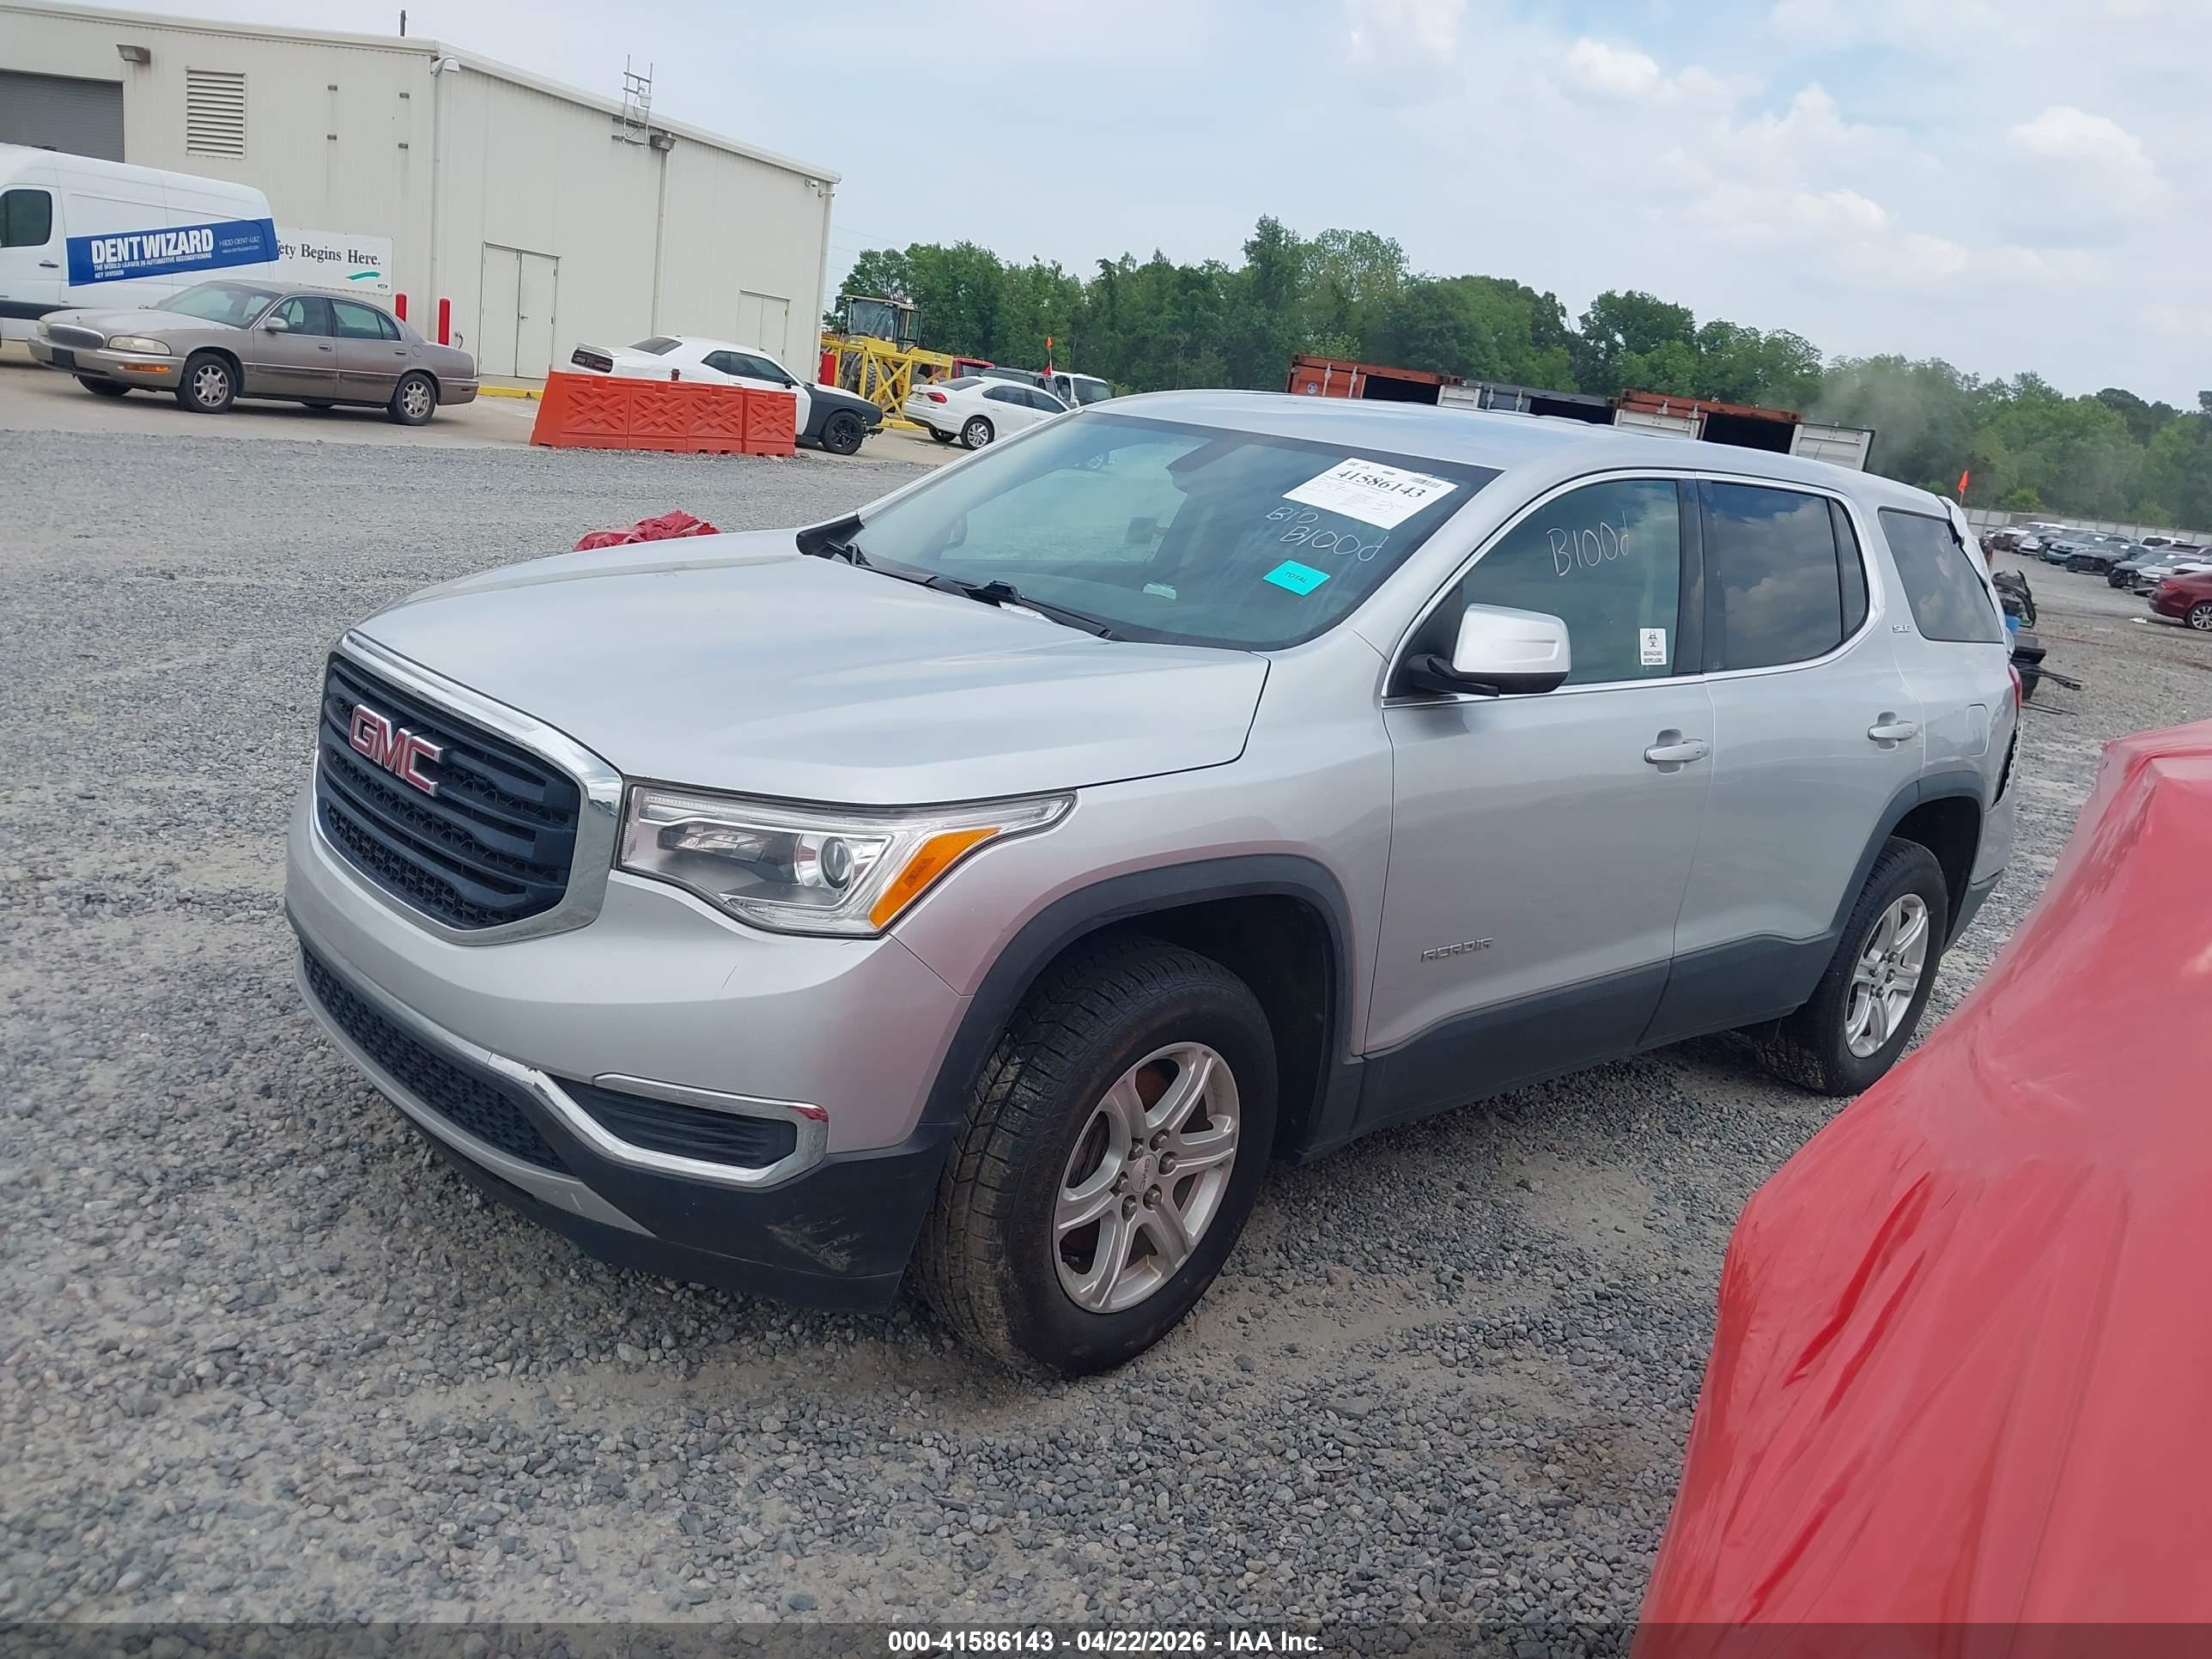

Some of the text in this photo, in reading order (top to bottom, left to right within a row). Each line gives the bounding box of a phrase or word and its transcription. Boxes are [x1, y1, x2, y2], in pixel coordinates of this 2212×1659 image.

[91, 228, 214, 264] DENT WIZARD
[276, 240, 296, 259] ety
[301, 243, 342, 264] Begins
[348, 249, 380, 265] Here.
[1337, 470, 1427, 499] 41586143
[1285, 570, 1308, 584] TOTAL
[349, 703, 443, 797] GMC
